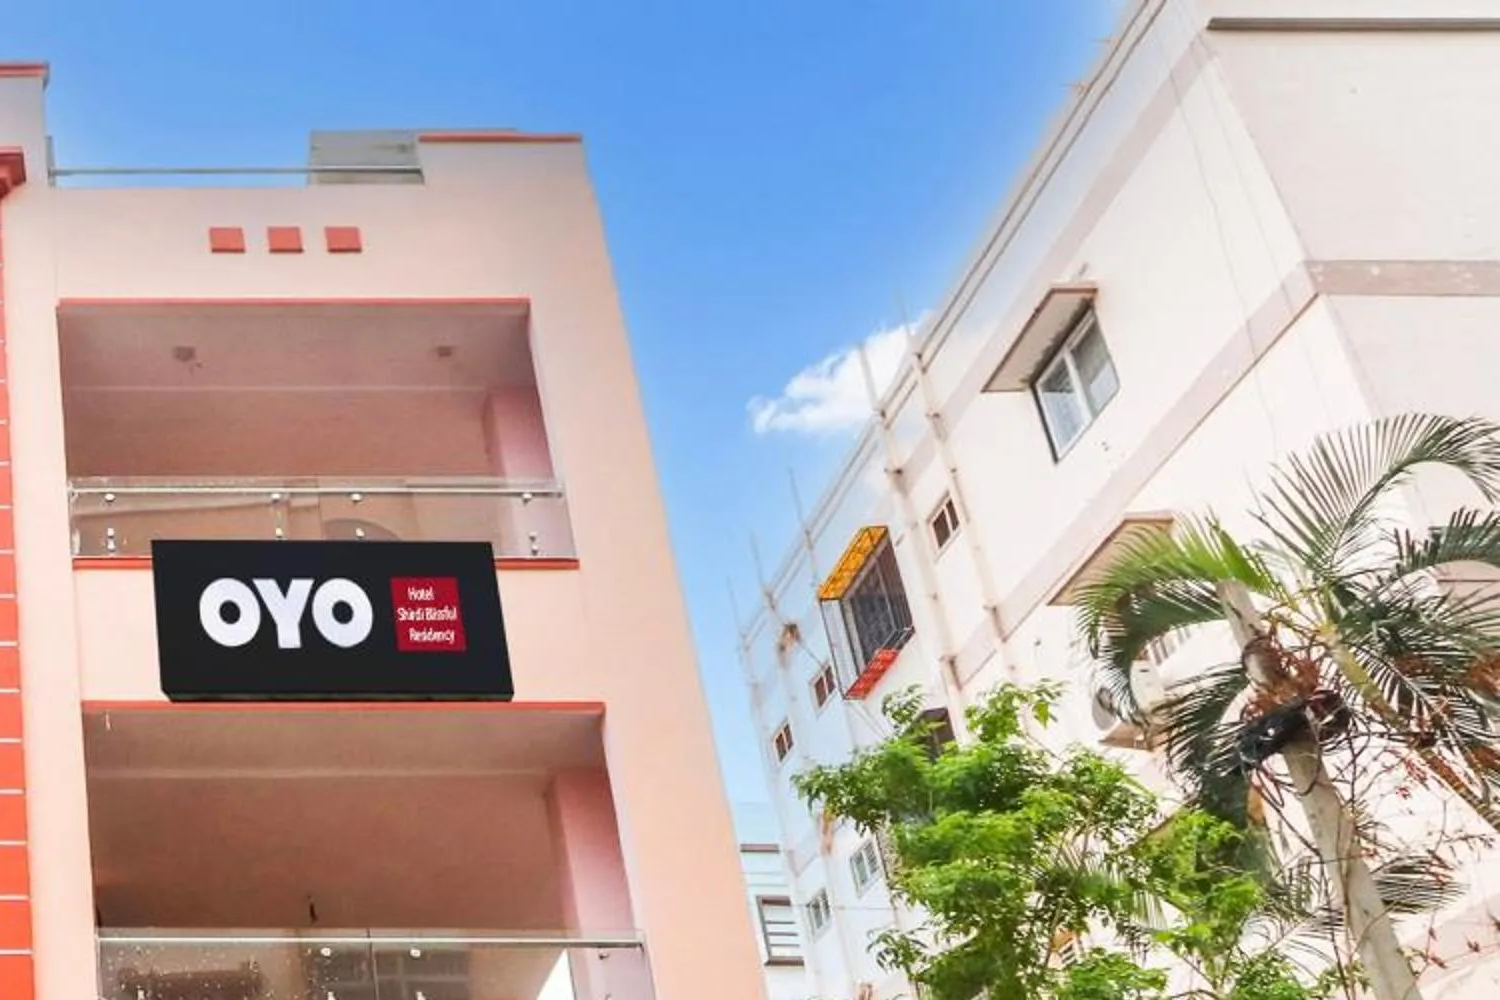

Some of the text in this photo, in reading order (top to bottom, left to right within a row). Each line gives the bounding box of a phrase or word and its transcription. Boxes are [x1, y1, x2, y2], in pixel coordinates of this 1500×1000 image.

[407, 586, 435, 601] Hotel
[199, 578, 373, 648] OYO
[409, 627, 455, 644] Residency
